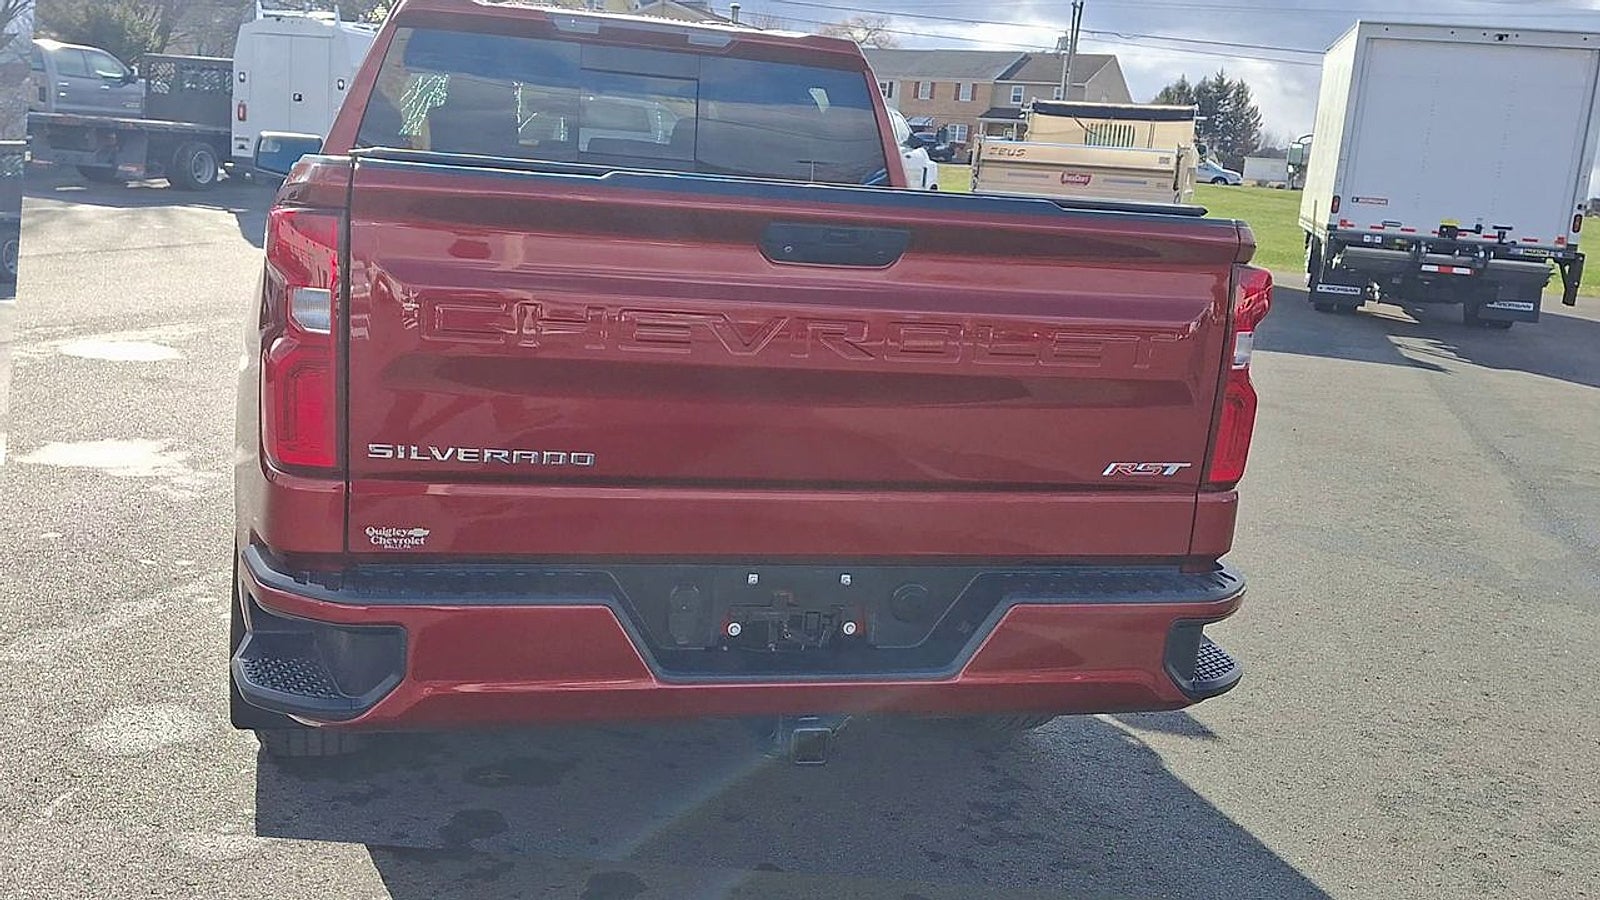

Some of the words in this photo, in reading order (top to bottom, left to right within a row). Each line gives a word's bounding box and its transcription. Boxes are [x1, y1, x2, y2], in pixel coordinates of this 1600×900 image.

[1498, 302, 1532, 310] MORGAN
[420, 299, 1184, 369] CHEVROLET
[367, 443, 596, 467] SILVERADO
[1102, 462, 1192, 476] RST
[365, 526, 409, 537] Quigley
[370, 535, 425, 545] Chevrolet
